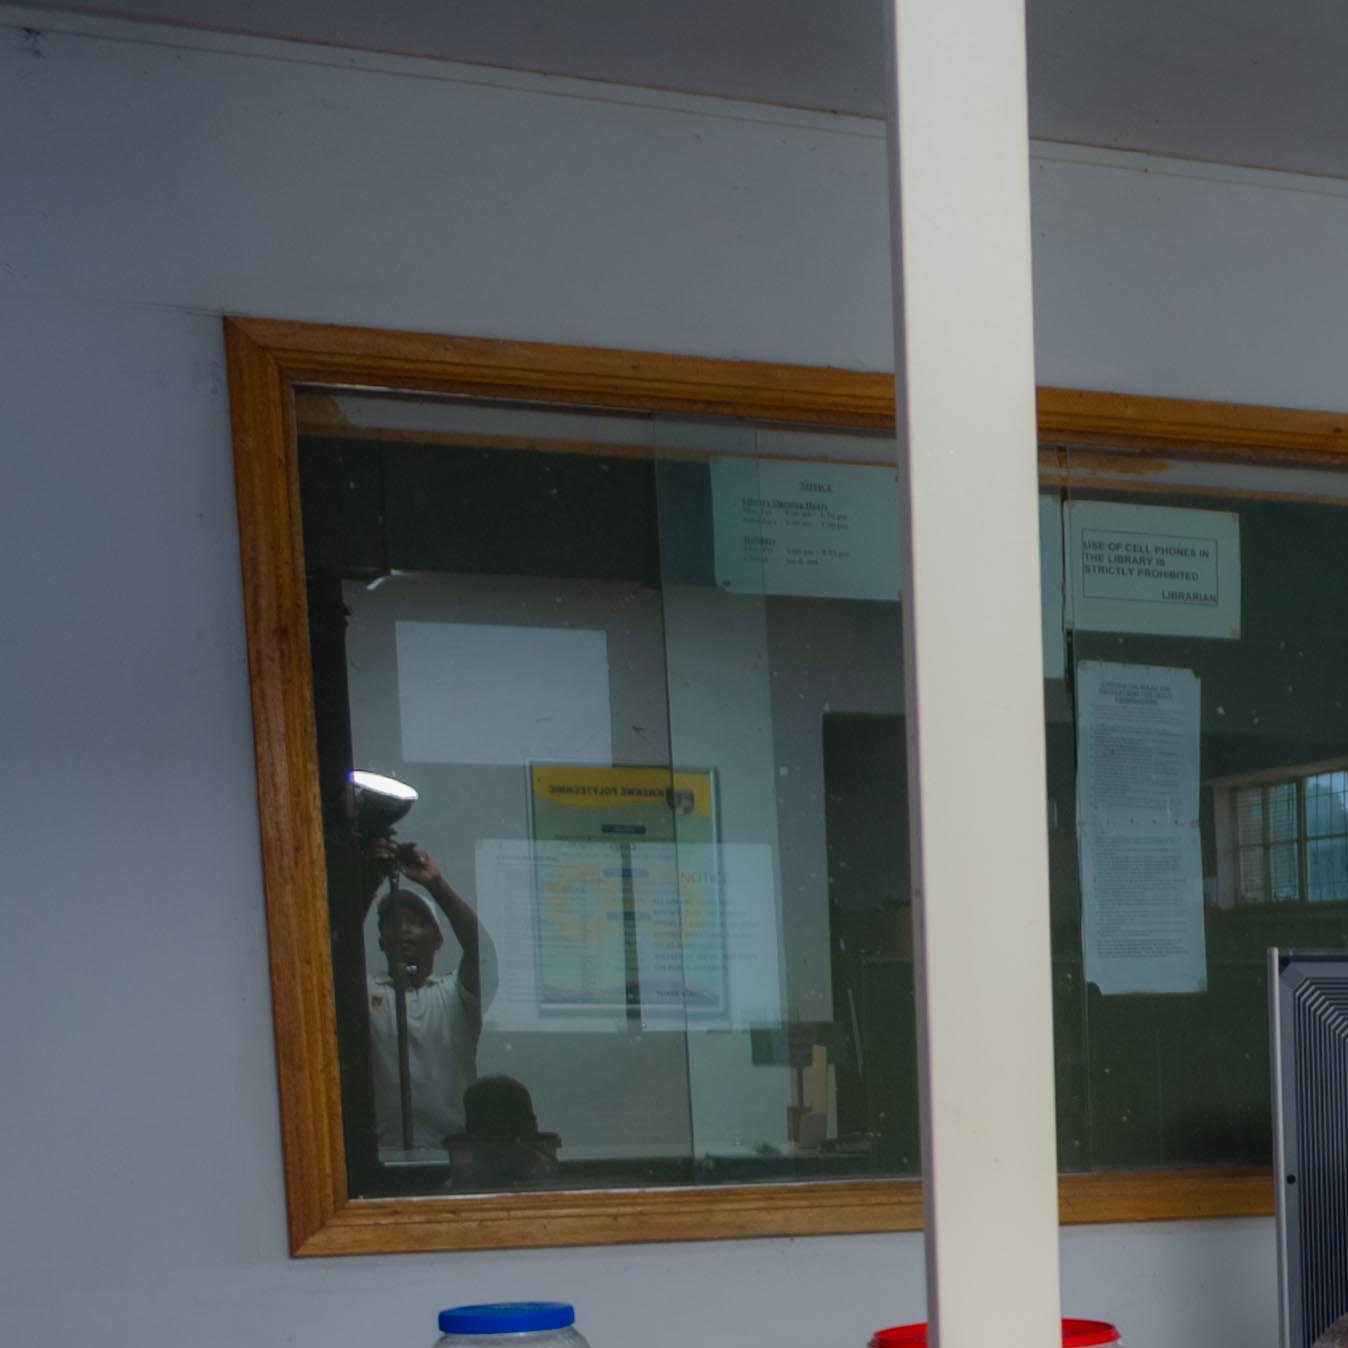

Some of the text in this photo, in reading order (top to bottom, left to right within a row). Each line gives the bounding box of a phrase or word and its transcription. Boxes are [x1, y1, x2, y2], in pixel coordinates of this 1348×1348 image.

[1084, 541, 1210, 559] USE OF CELL PHONES IN
[1085, 552, 1166, 567] THE LIBRARY IS
[1085, 565, 1199, 581] STRICTLY PROHIBITED
[1161, 589, 1217, 602] LIBRARIAN
